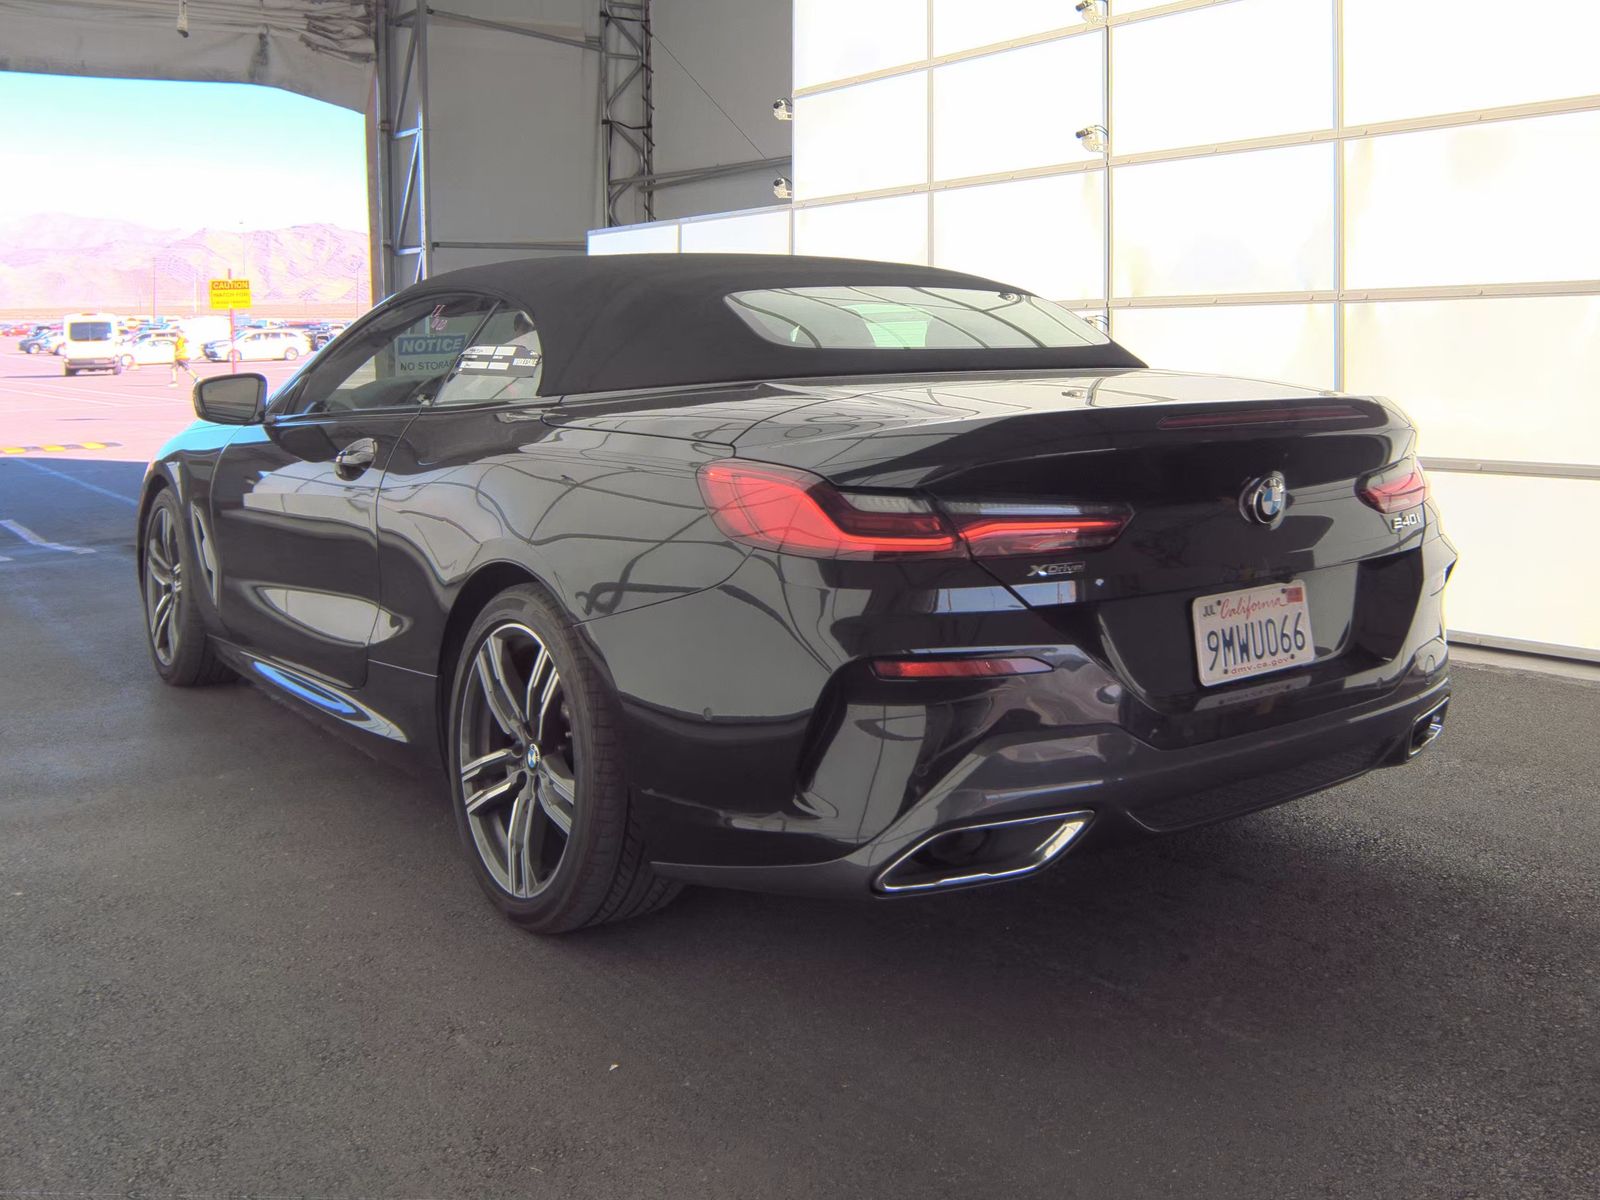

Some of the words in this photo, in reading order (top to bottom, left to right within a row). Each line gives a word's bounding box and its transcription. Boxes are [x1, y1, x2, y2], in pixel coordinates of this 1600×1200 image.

[213, 281, 249, 289] CAUTION
[402, 338, 462, 353] NOTICE
[400, 362, 415, 371] NO
[1220, 595, 1289, 620] California
[1207, 612, 1306, 671] 9MWU066
[1231, 657, 1289, 675] dmv.ca.gov
